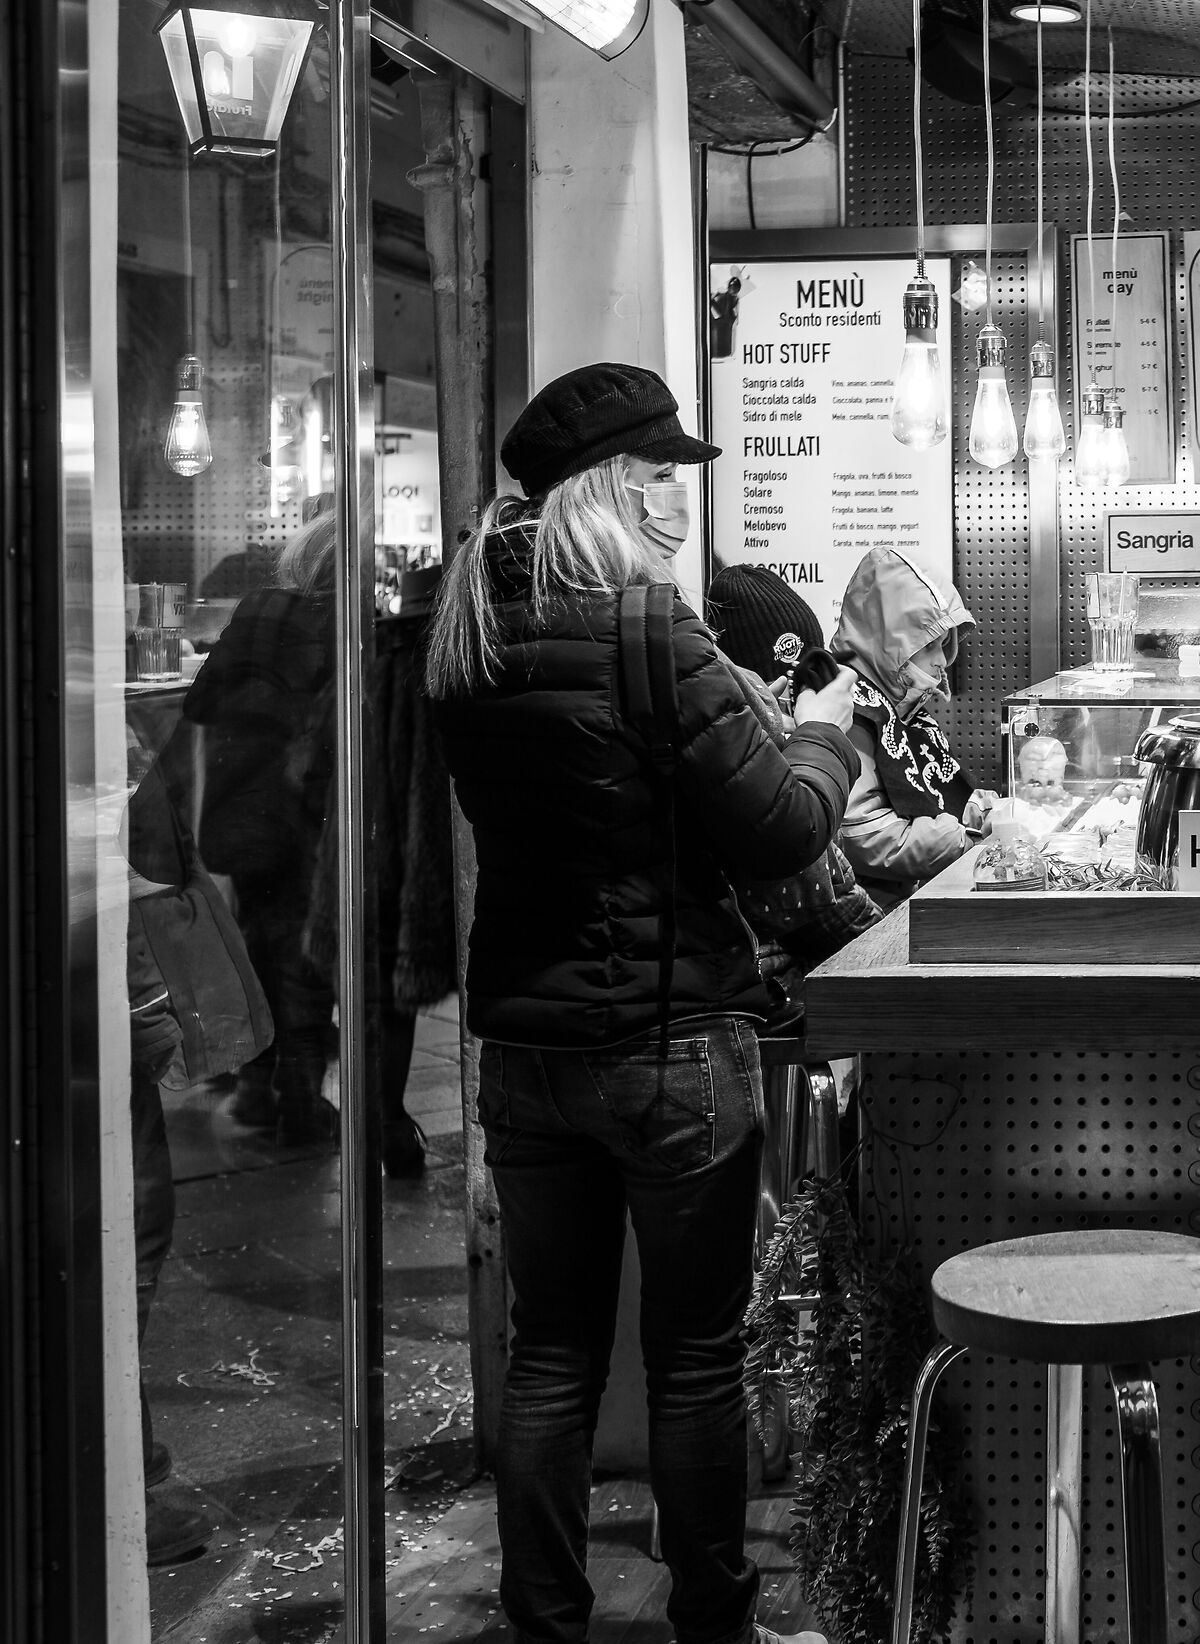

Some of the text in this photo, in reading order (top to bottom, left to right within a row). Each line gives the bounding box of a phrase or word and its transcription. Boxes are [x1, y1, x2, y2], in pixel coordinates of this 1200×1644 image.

[797, 272, 864, 308] MENÙ
[780, 310, 881, 327] Sconto residenti
[744, 343, 831, 364] HOT STUFF
[742, 376, 804, 391] Sangria calda
[742, 393, 816, 406] Cioccolata calda
[743, 410, 802, 422] Sidro di mele
[744, 436, 820, 457] FRULLATI
[744, 470, 787, 484] Fragoloso
[743, 487, 772, 498] Solare
[743, 504, 784, 515] Cremoso
[743, 520, 787, 532] Melobevo
[743, 537, 769, 548] Attivo
[1117, 530, 1194, 553] Sangria
[747, 562, 824, 583] KTAIL
